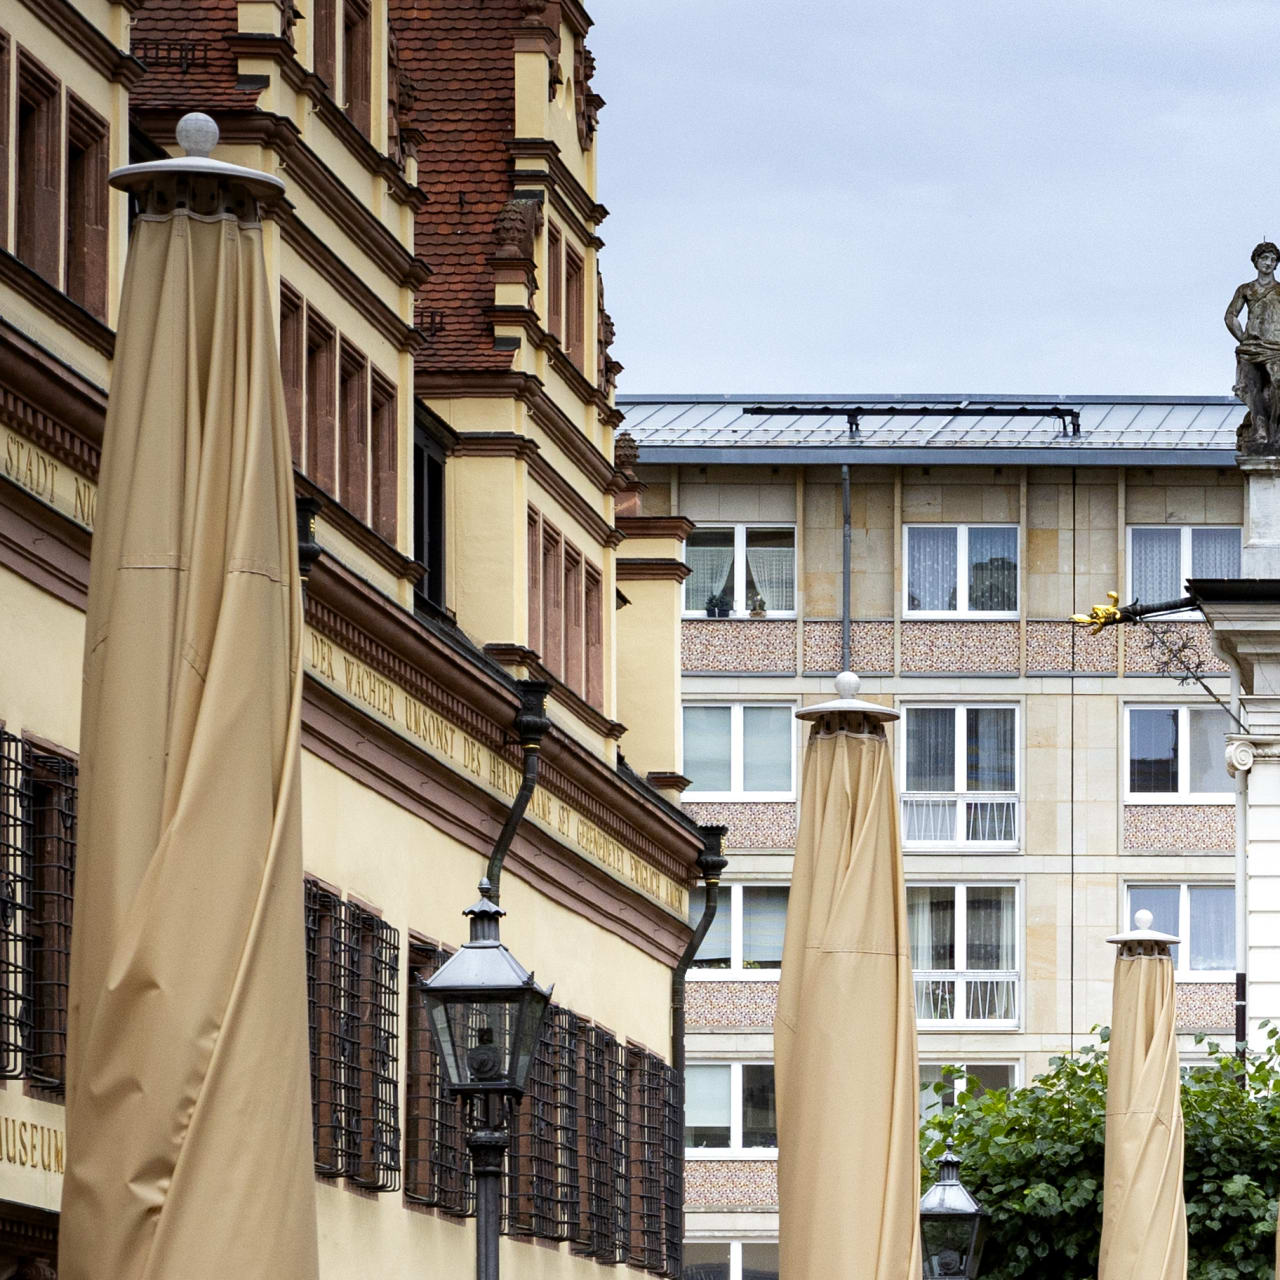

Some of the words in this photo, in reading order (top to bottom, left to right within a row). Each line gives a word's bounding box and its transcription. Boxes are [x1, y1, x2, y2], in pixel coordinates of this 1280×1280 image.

[5, 432, 58, 504] STADT
[311, 631, 336, 682] DER
[404, 695, 456, 760] UMSONST
[463, 735, 481, 777] DES
[0, 1115, 64, 1175] USEUM
